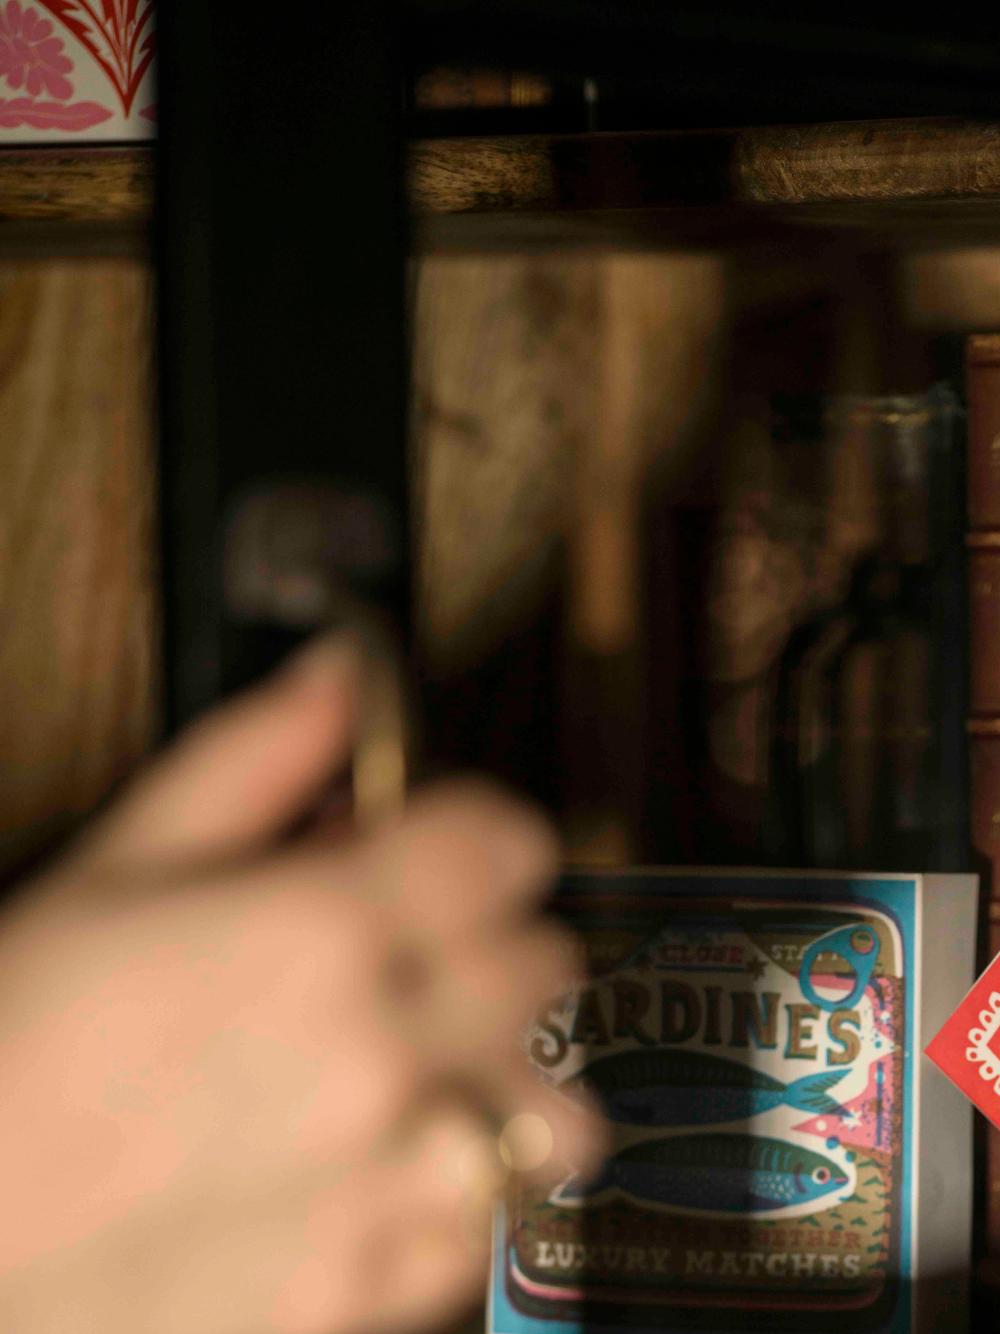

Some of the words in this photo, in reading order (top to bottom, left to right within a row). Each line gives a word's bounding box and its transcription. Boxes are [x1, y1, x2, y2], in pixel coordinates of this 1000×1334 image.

[530, 978, 862, 1067] SARDINES
[535, 1241, 671, 1273] LUXURY
[684, 1249, 861, 1278] MATCHES
